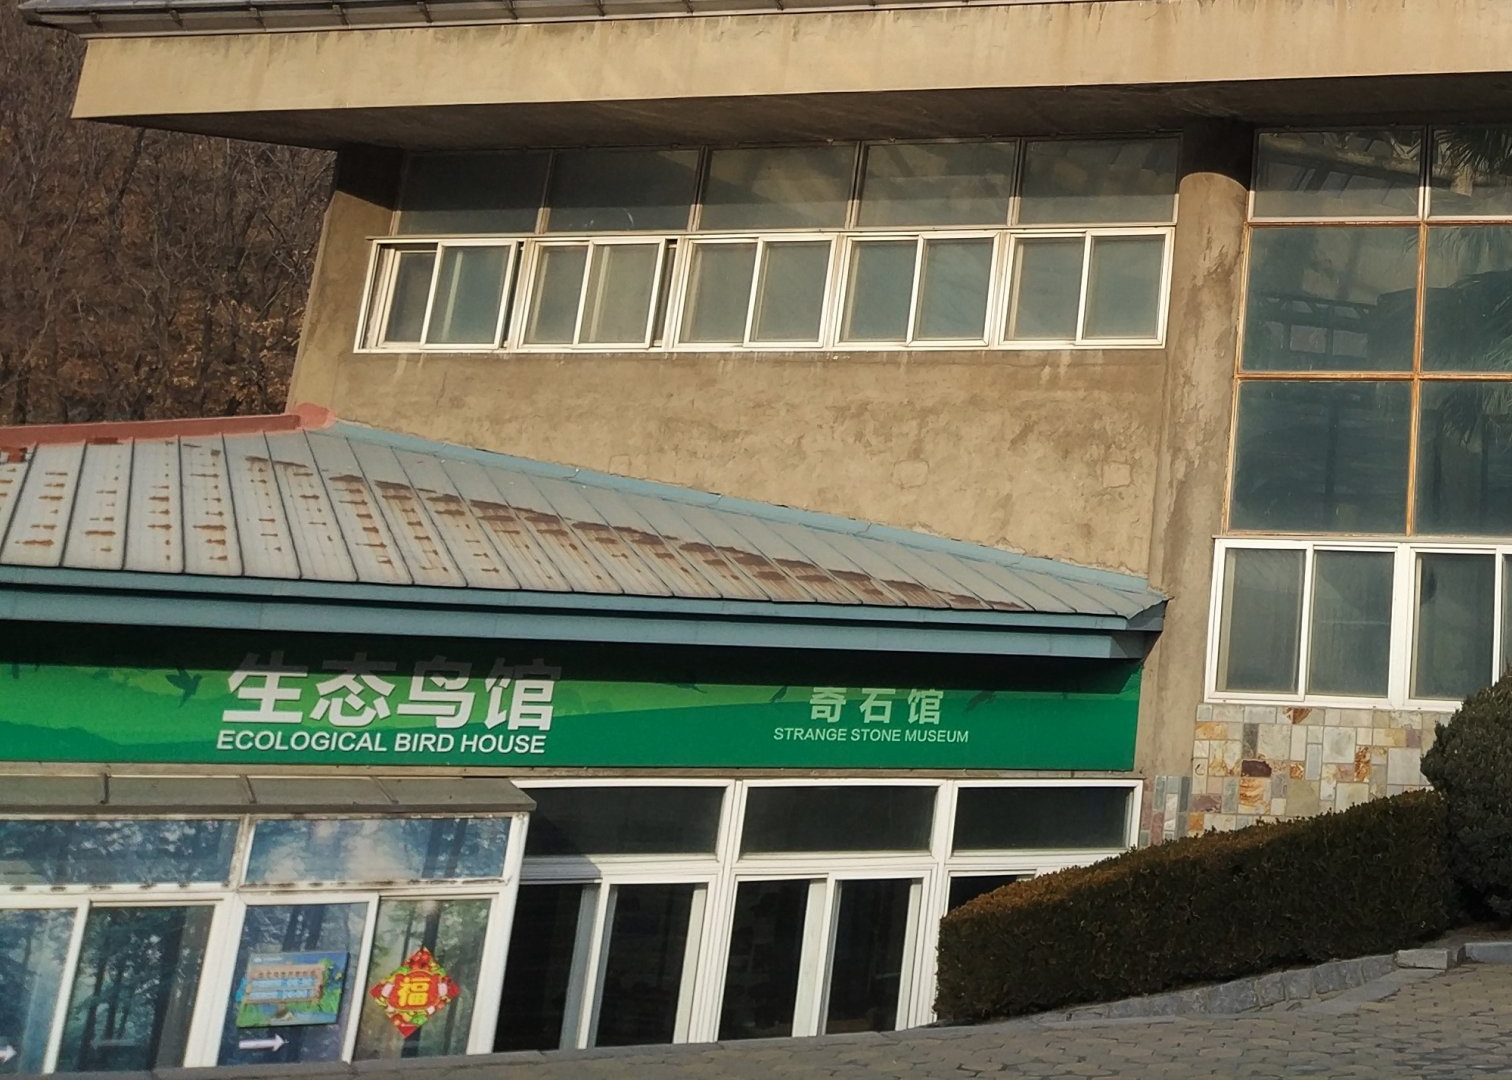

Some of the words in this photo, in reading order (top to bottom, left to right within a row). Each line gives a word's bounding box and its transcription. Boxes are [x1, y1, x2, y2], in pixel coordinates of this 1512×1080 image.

[222, 650, 562, 731] 生态鸟馆
[809, 686, 945, 725] 奇石馆
[216, 729, 388, 752] ECOLOGICAL
[393, 732, 455, 753] BIRD
[459, 734, 547, 754] HOUSE
[773, 727, 848, 742] STRANGE
[850, 728, 901, 743] STONE
[904, 729, 969, 743] MUSEUM
[396, 975, 432, 1008] 福
